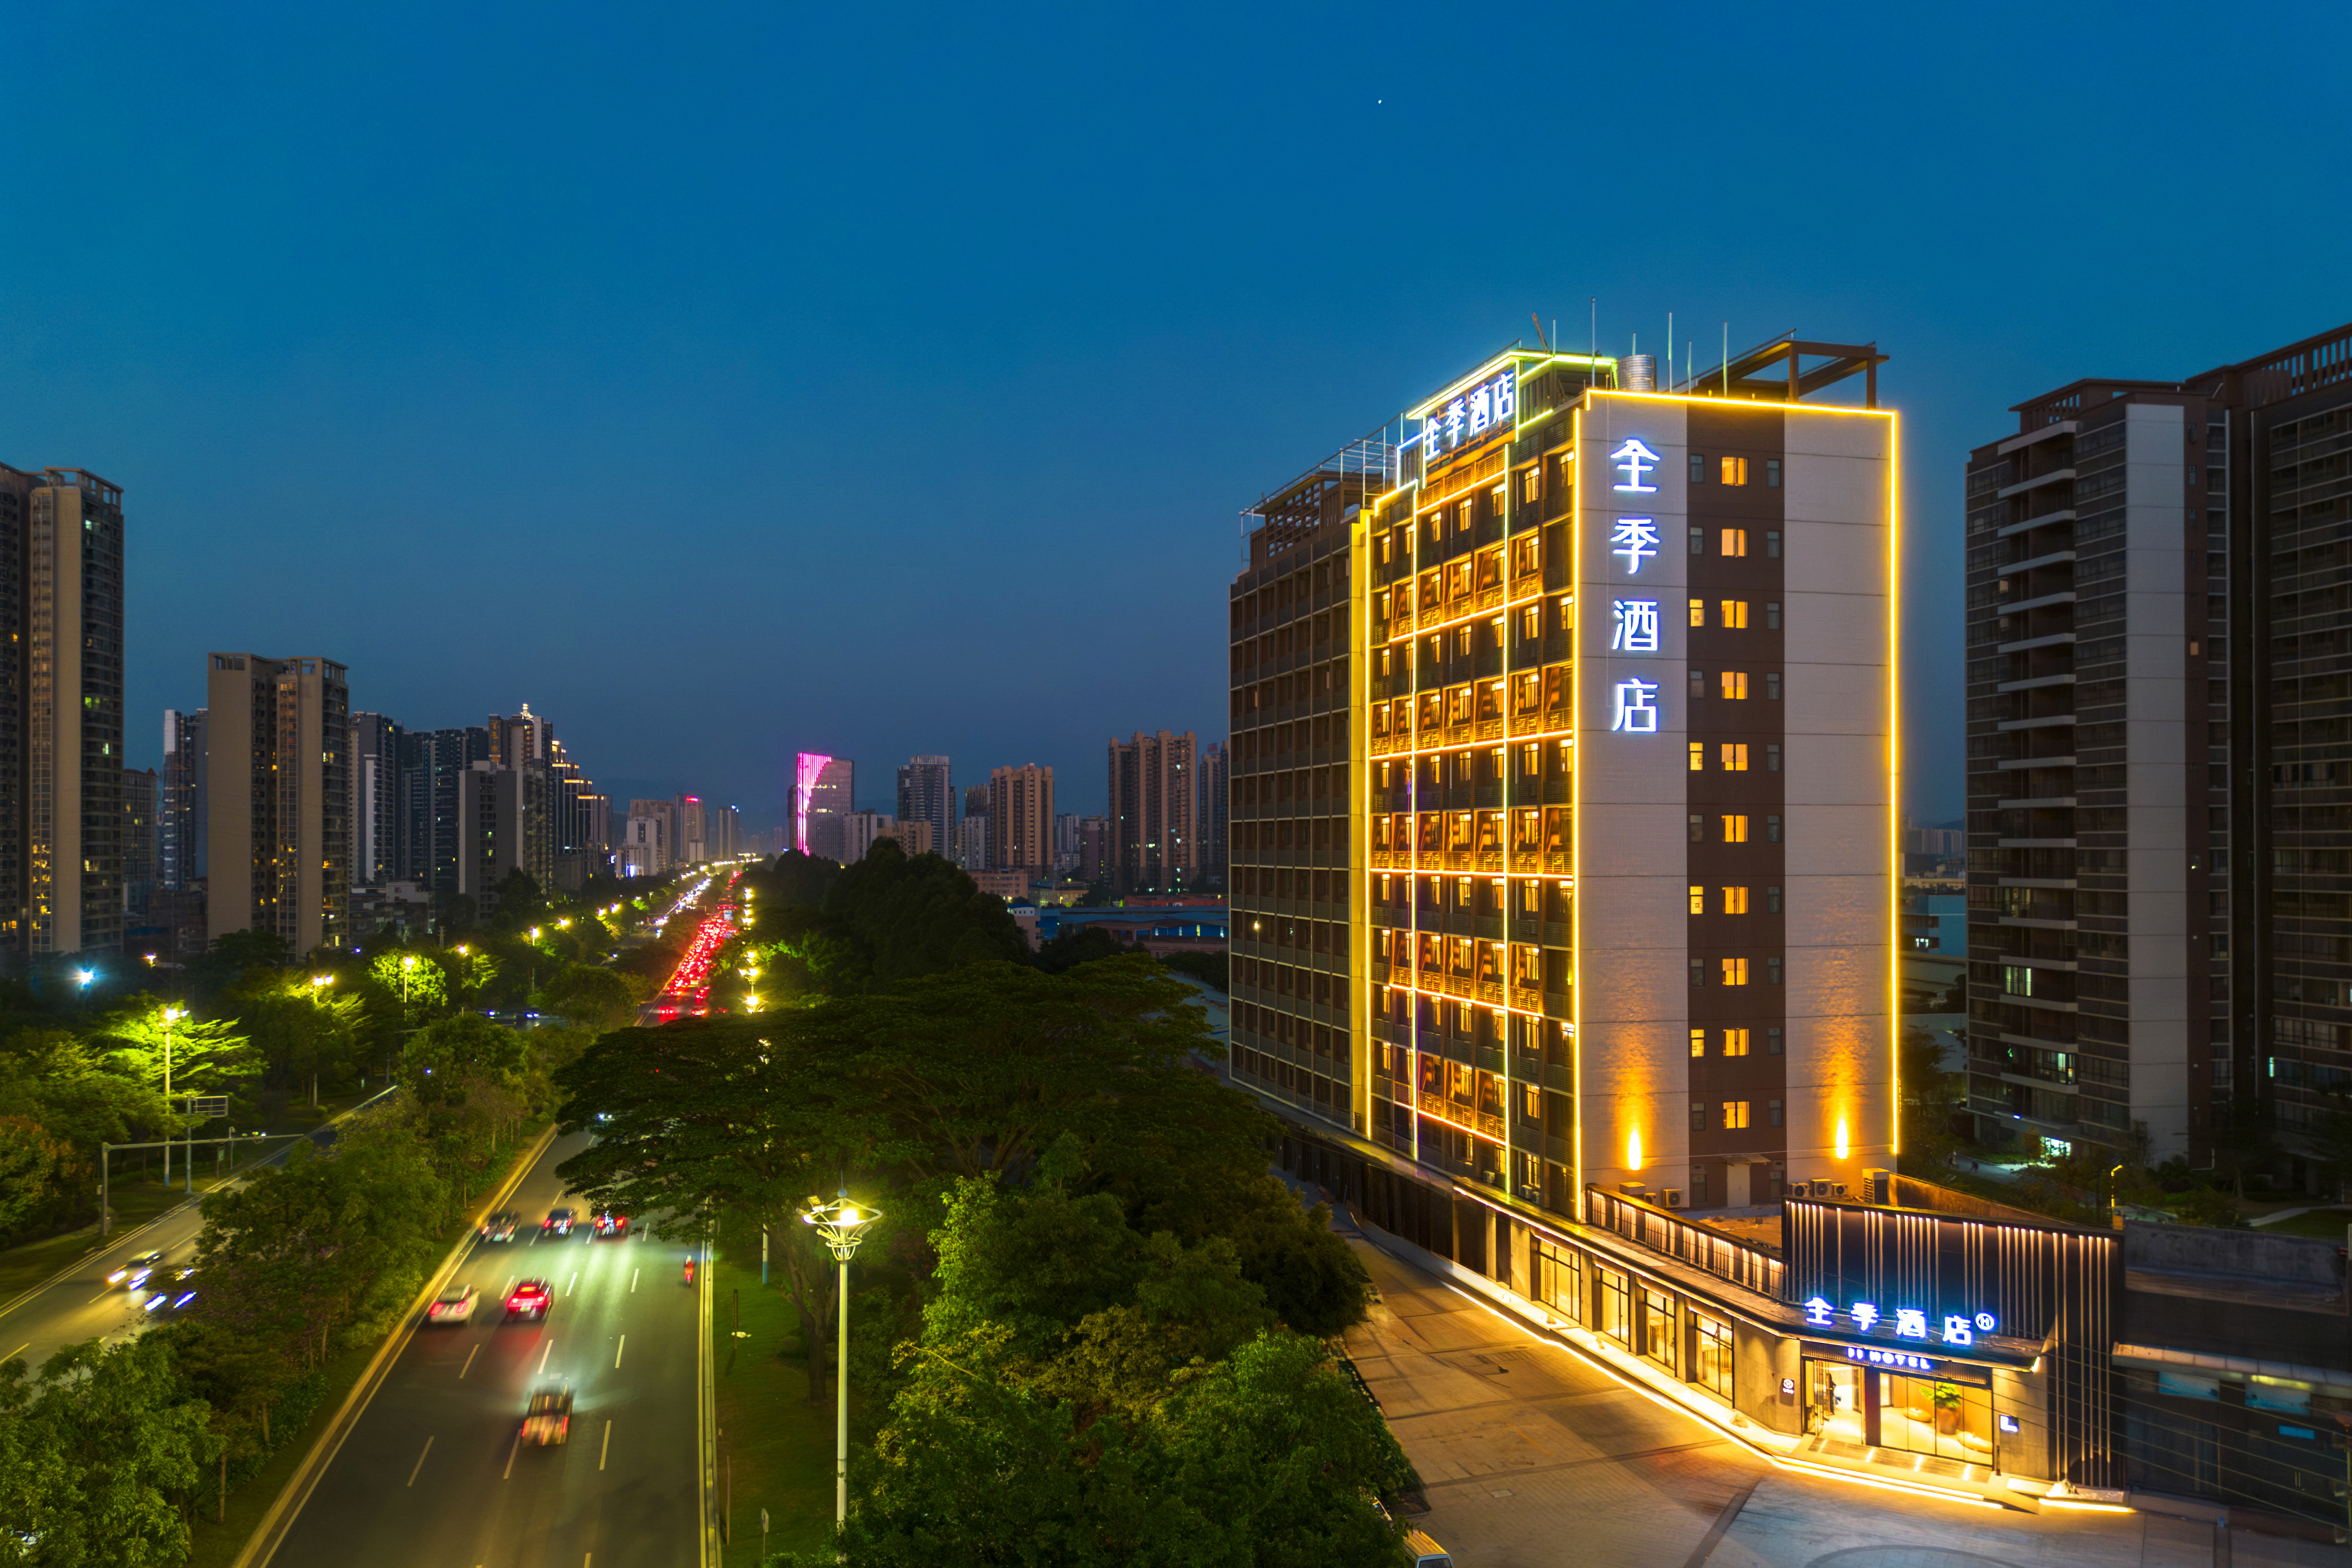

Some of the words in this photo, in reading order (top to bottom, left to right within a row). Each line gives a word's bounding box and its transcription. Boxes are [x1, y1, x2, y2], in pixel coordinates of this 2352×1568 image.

[1424, 373, 1514, 461] 全季酒店
[1609, 439, 1661, 733] 全季酒店
[1804, 1297, 1972, 1345] 全季酒店
[1869, 1350, 1930, 1370] HOTEL
